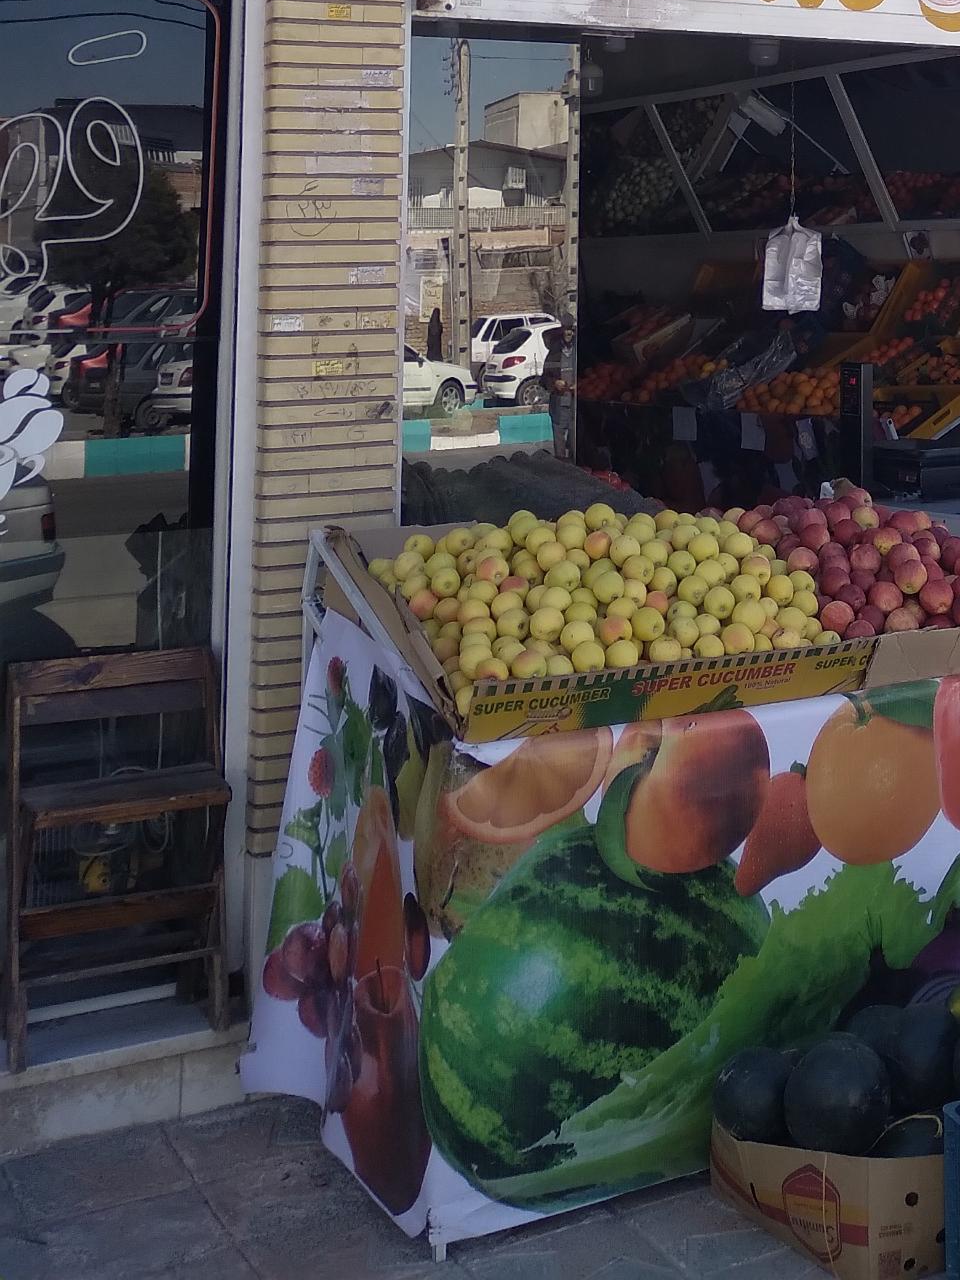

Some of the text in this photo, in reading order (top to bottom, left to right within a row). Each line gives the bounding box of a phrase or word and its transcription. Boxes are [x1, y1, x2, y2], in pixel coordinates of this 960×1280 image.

[815, 655, 857, 670] SUPER
[631, 662, 797, 697] SUPER CUCUMBER
[473, 687, 611, 716] SUPER CUCUMBER
